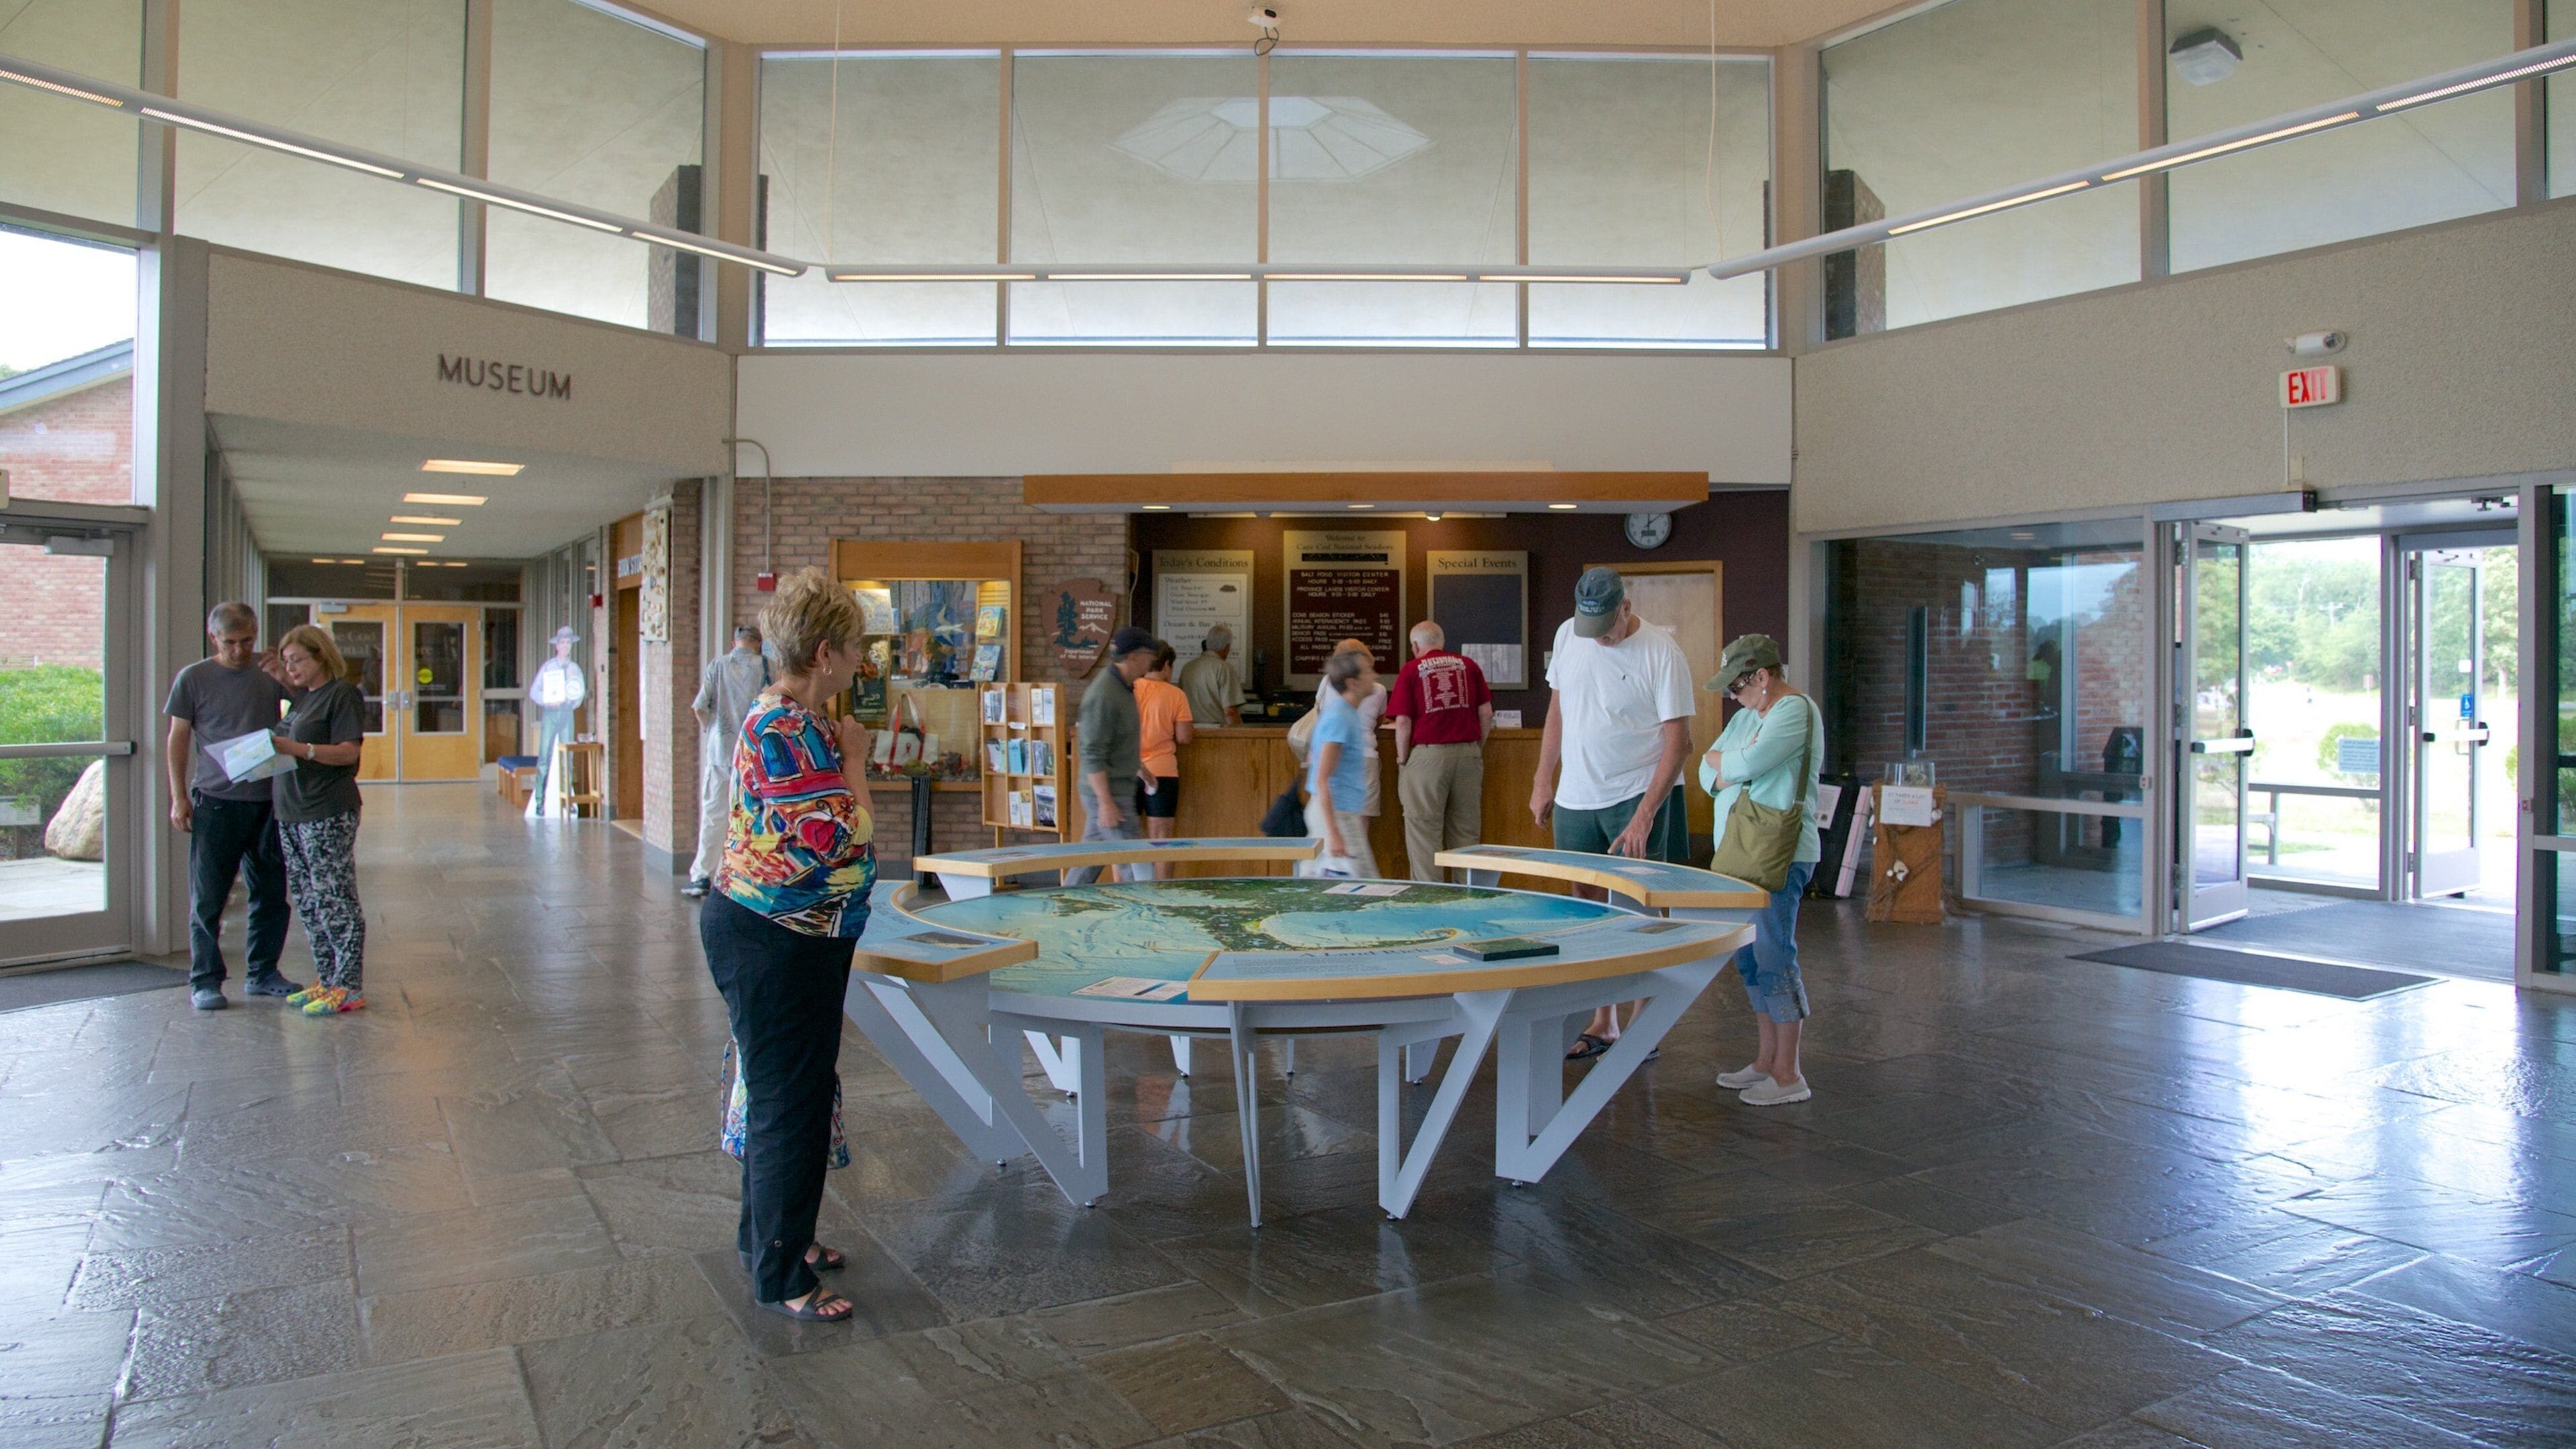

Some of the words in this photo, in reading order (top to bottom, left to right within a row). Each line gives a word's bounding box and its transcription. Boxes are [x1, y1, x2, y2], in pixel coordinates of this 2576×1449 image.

[437, 353, 570, 400] MUSEUM
[2288, 368, 2328, 404] EXIT
[1159, 557, 1193, 569] Today's
[1196, 557, 1248, 568] Conditions
[1438, 557, 1477, 570] Special
[1482, 557, 1517, 568] Events
